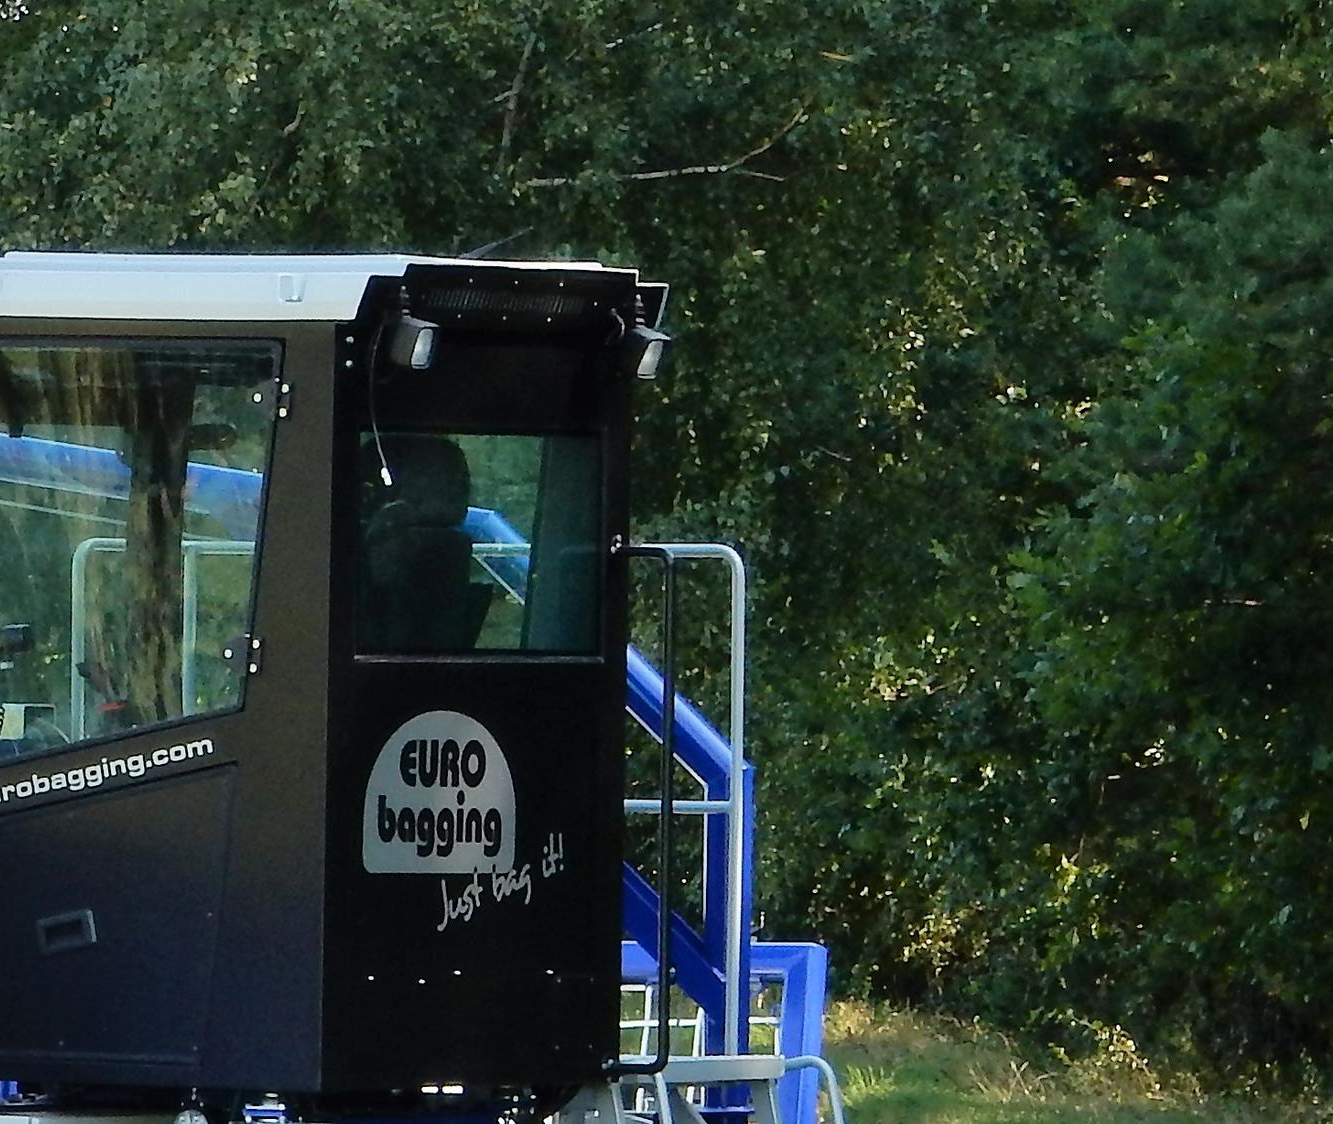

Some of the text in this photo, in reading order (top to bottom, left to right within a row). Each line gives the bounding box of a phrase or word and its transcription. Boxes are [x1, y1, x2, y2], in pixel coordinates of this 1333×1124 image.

[399, 738, 487, 788] EURO
[377, 792, 503, 858] bagging
[436, 832, 565, 932] Just bag it!
